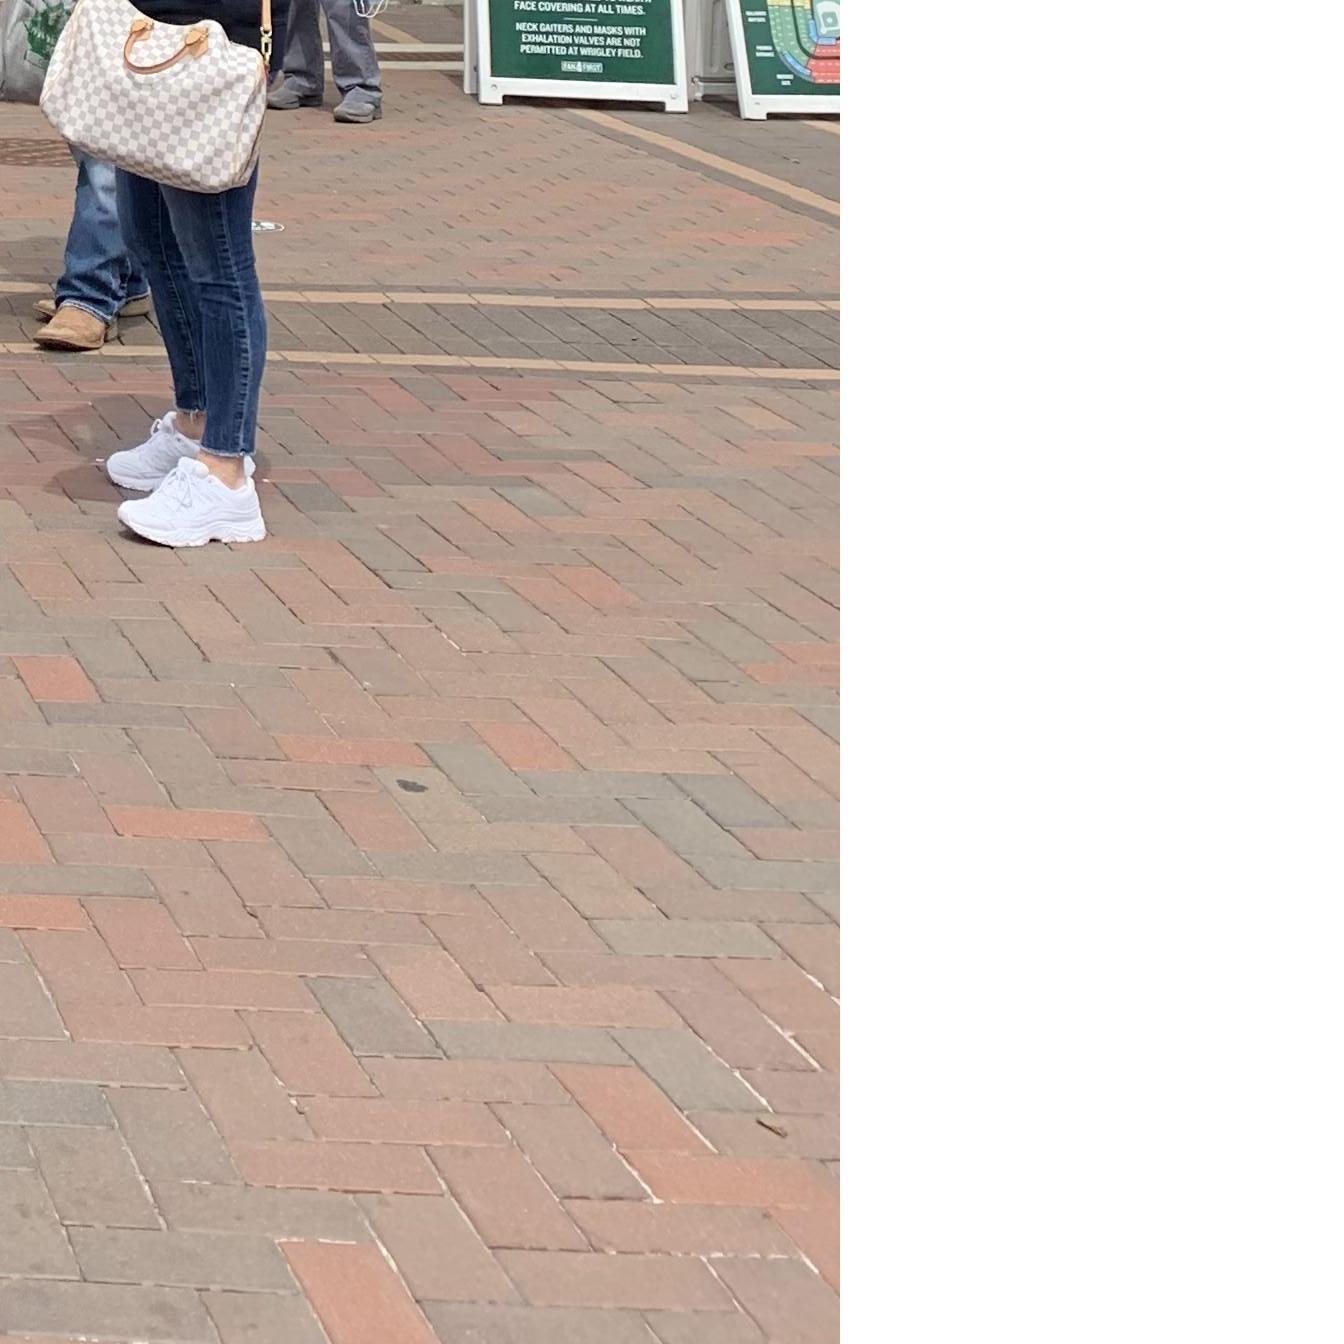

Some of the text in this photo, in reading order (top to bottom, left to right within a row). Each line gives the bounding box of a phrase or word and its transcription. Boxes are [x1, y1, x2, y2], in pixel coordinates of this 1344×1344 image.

[514, 1, 646, 15] FACE COVERING AT ALL TIMES.
[516, 22, 646, 36] NECK GAITERS AND MASKS WITH
[522, 34, 640, 47] EXHALATION VALVES ARE NOT
[520, 45, 644, 58] PERMITTED AT WRIGLEY FIELD.
